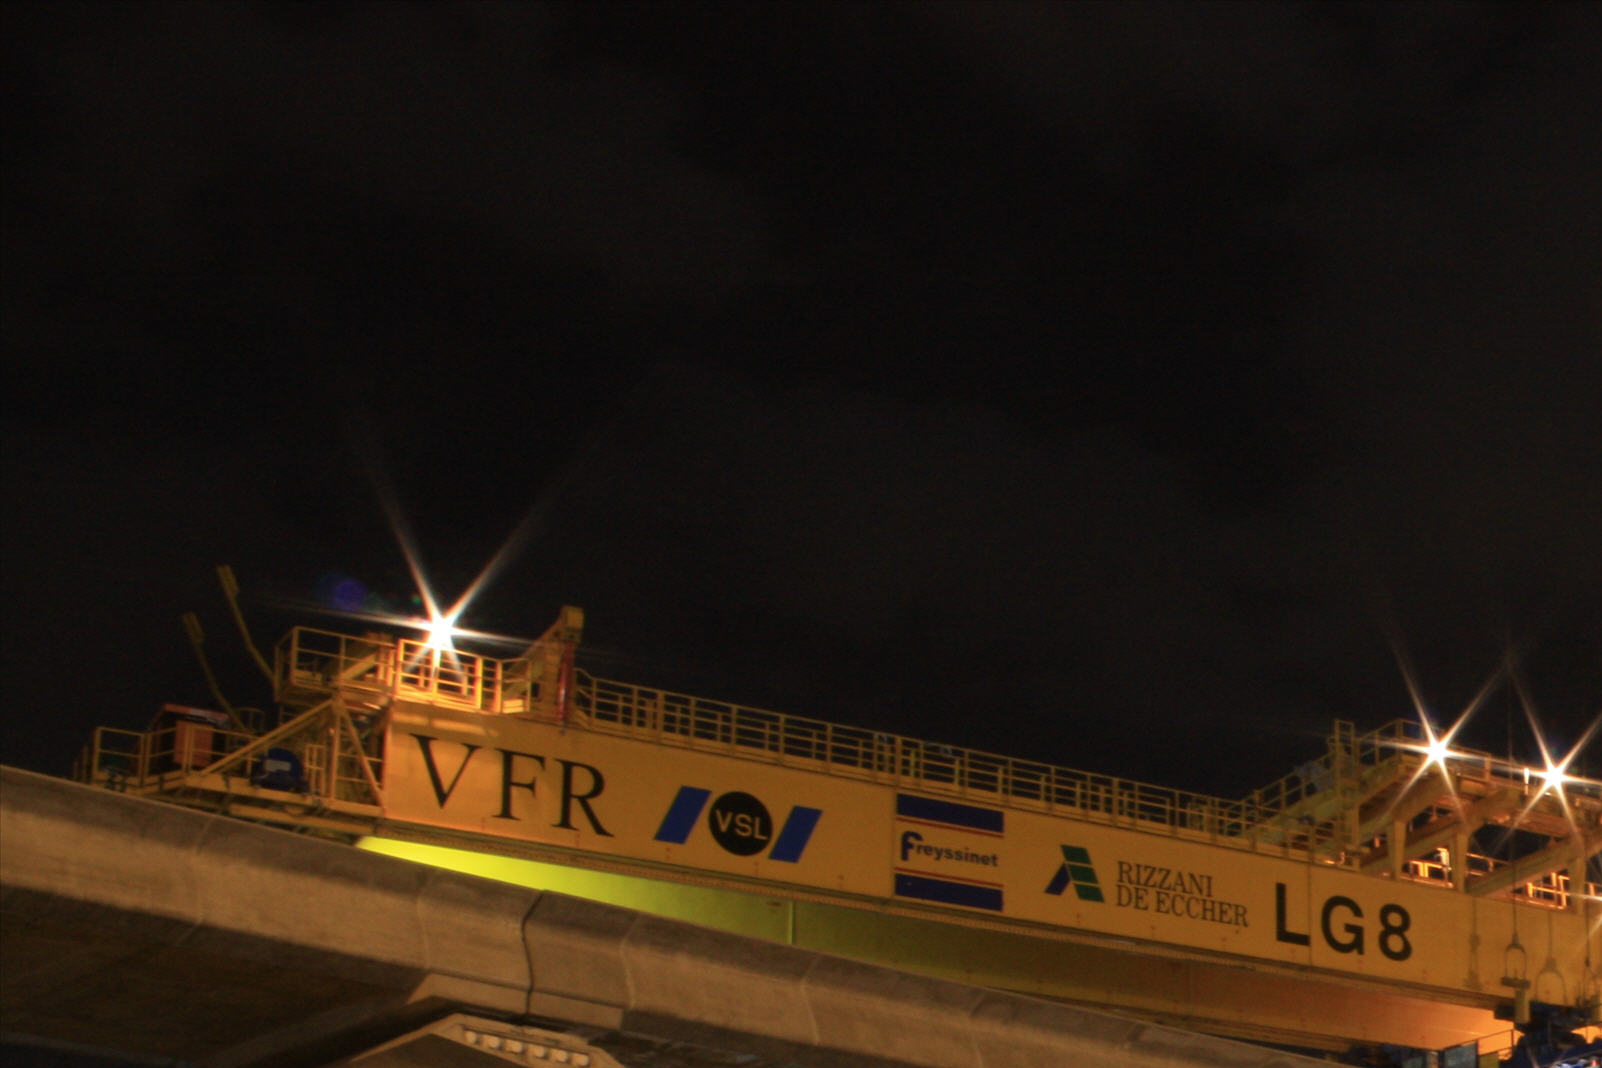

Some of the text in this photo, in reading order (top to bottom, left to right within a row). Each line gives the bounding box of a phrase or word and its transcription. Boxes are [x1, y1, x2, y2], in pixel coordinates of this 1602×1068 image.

[410, 734, 614, 838] VFR
[715, 810, 768, 841] VSL
[1117, 861, 1213, 898] RIZZANI
[1116, 884, 1249, 928] DE ECCHER
[1275, 882, 1412, 961] LG8
